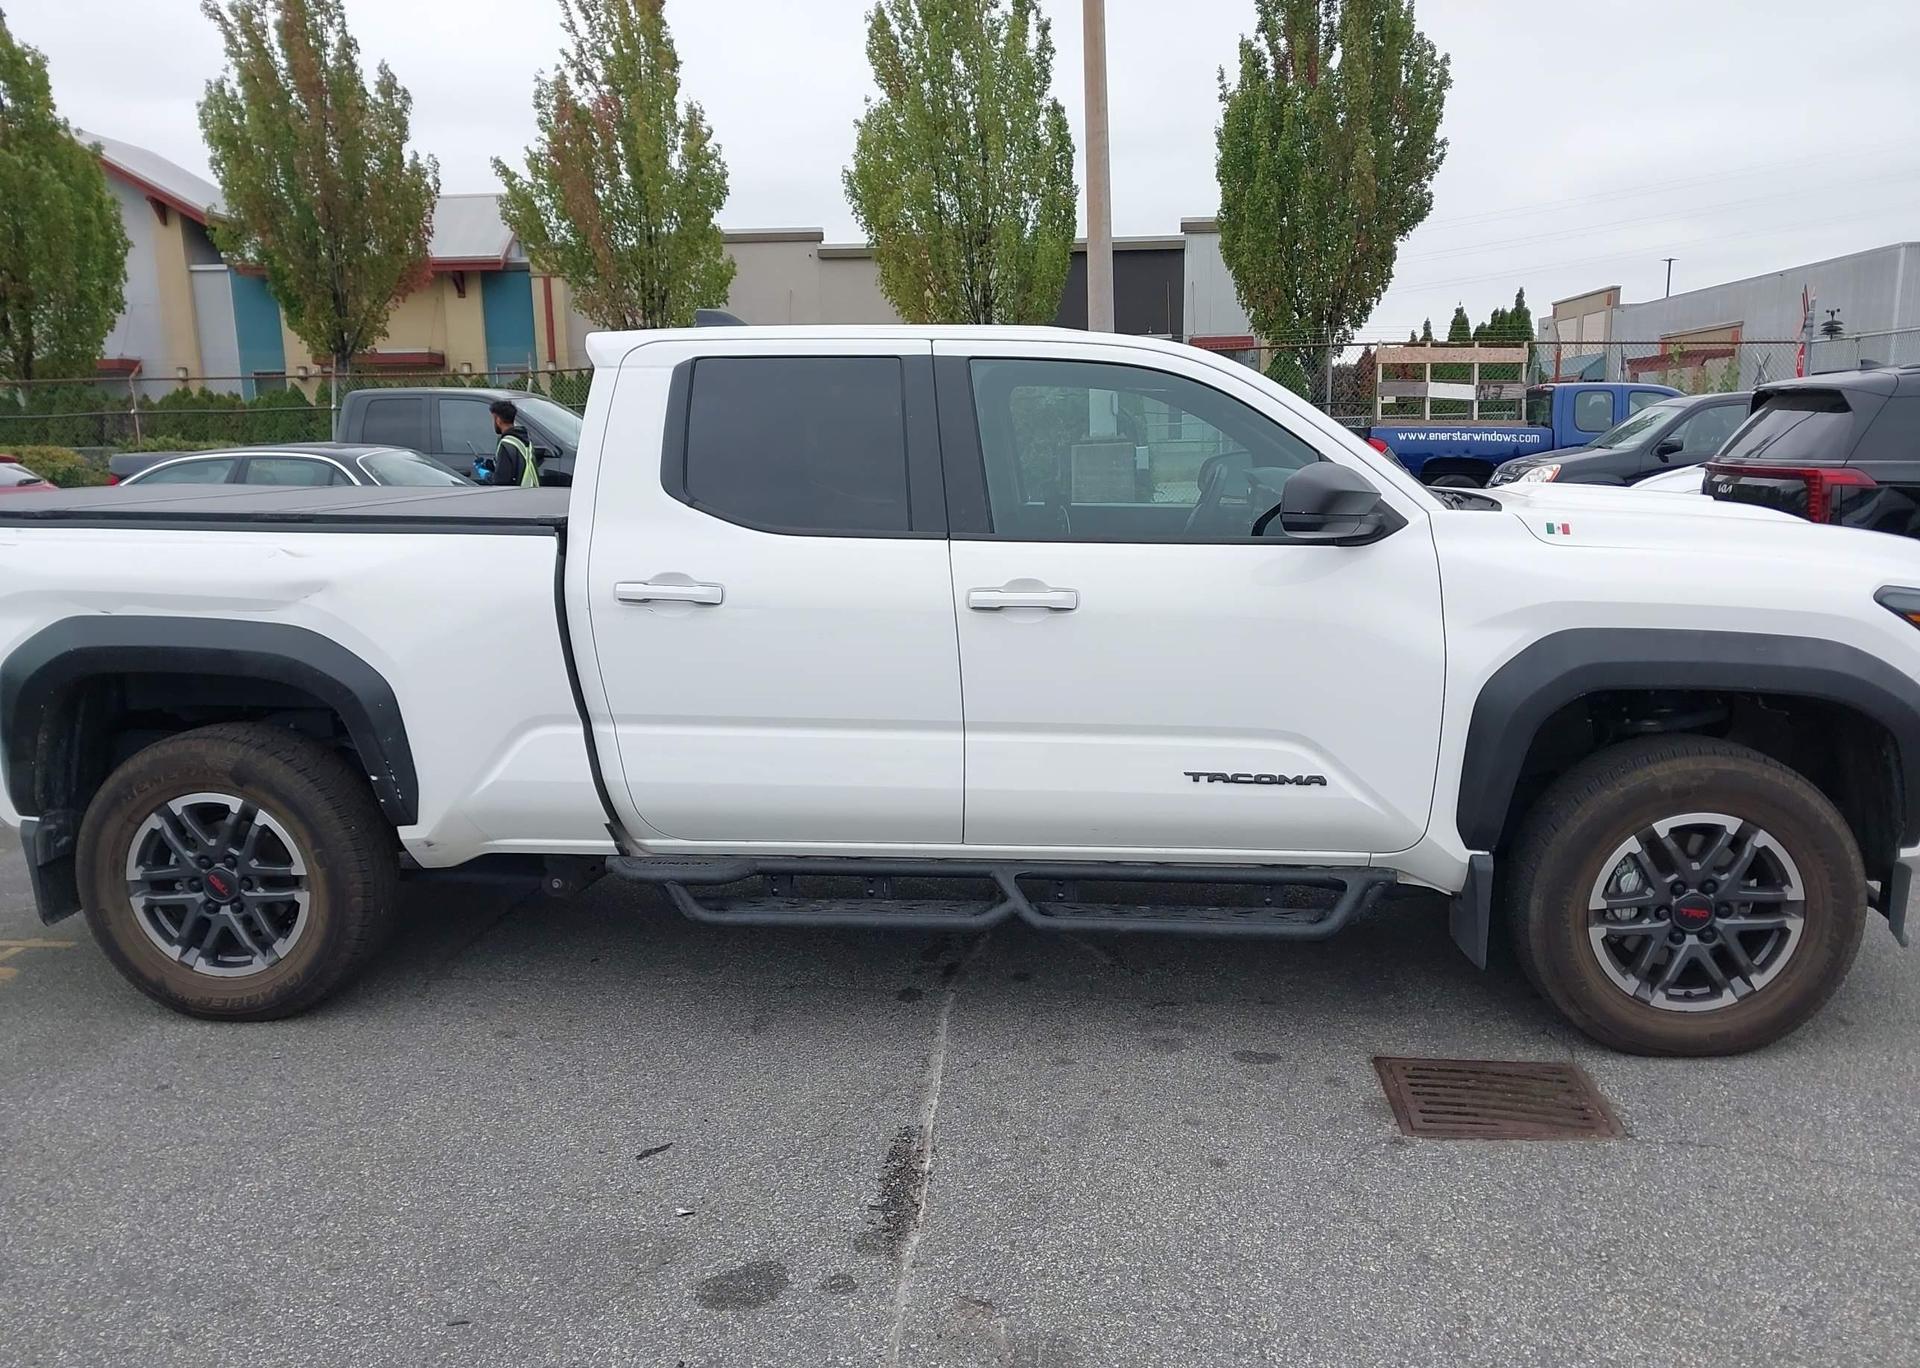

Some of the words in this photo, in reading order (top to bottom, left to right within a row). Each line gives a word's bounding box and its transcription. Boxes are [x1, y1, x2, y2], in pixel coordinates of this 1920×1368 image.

[1397, 431, 1540, 443] www.enerstarwindows.com
[1184, 772, 1327, 786] TACOMA
[1680, 908, 1709, 919] TRD
